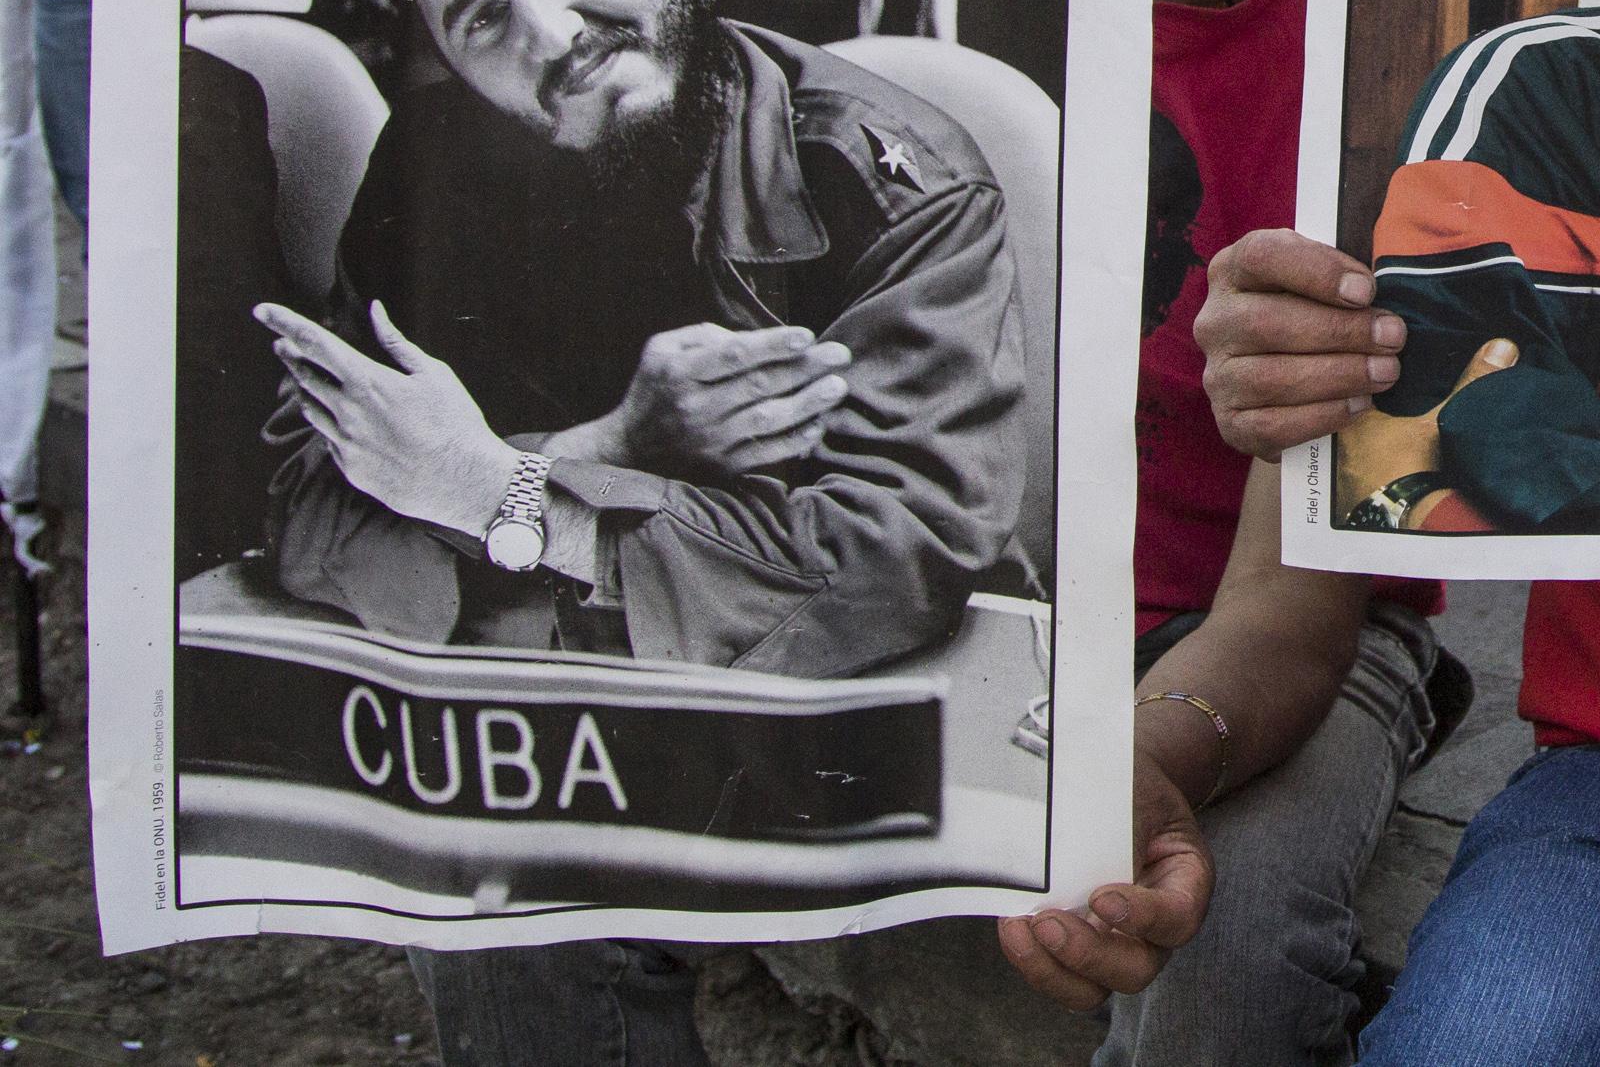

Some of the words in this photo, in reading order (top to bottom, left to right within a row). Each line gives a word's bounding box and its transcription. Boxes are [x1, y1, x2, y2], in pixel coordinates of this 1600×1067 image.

[1306, 442, 1320, 486] Chávez.
[1309, 488, 1321, 496] y
[1306, 497, 1318, 525] Fidel
[153, 688, 164, 718] Salas
[153, 719, 164, 761] Roberto
[341, 685, 629, 811] CUBA
[152, 778, 165, 812] 1959.
[153, 814, 165, 847] ONU.
[153, 848, 166, 860] la
[156, 863, 166, 878] en
[154, 880, 167, 911] Fidel
